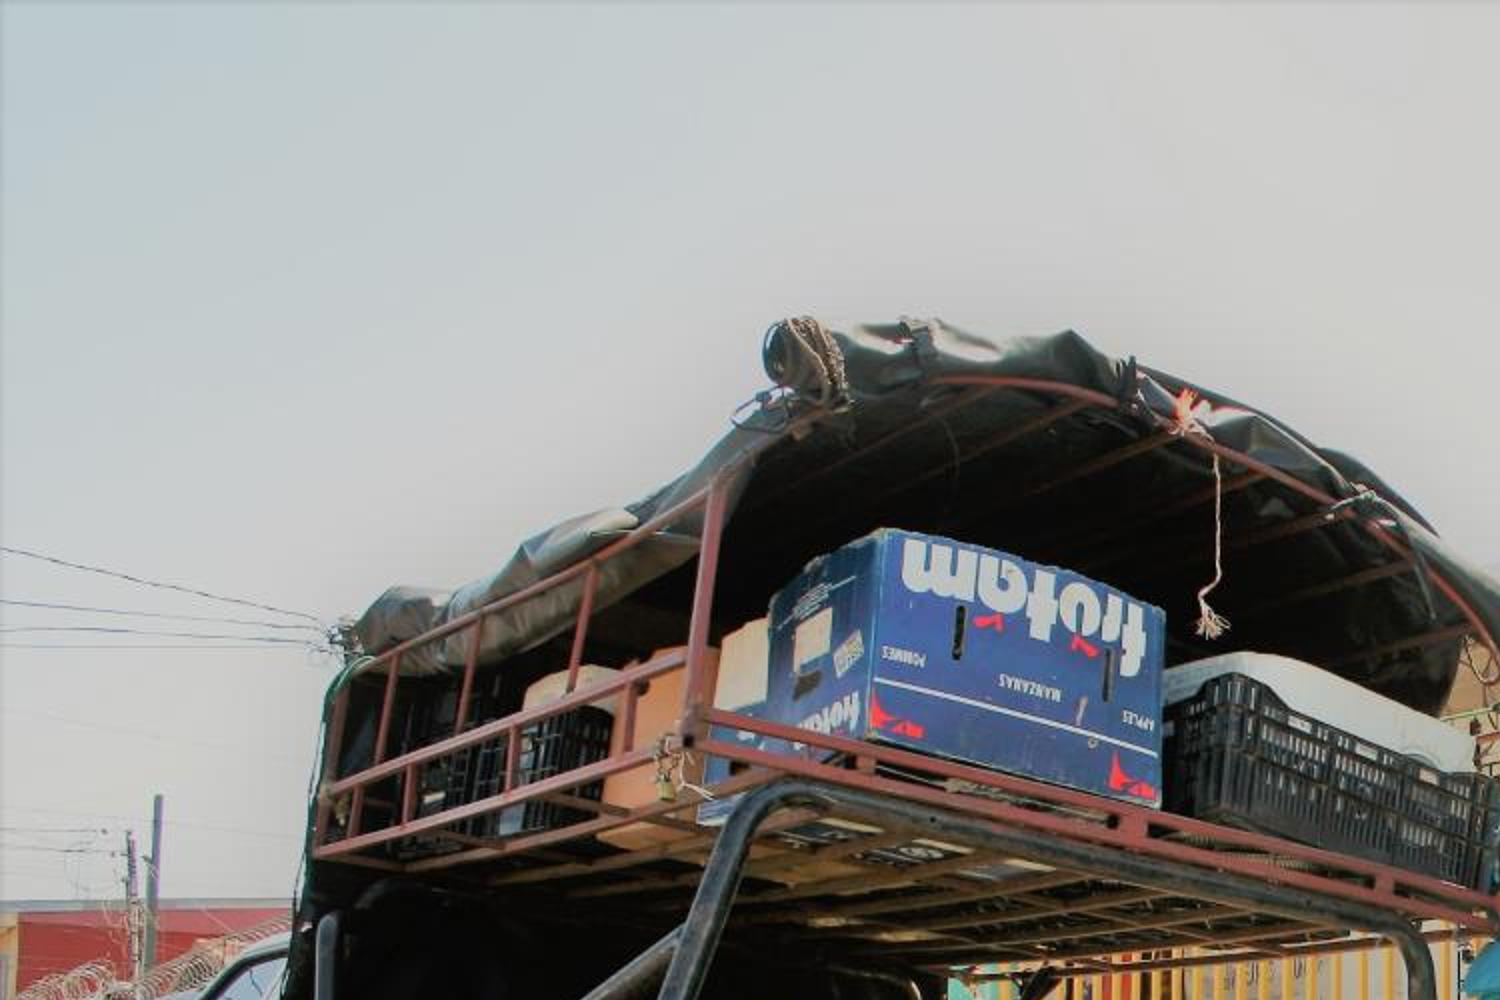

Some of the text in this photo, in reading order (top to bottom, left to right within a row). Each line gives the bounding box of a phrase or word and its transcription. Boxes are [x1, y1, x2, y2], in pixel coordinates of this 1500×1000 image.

[882, 645, 927, 668] POMMES
[999, 673, 1061, 703] MANZANAS
[1122, 710, 1155, 731] APPLES
